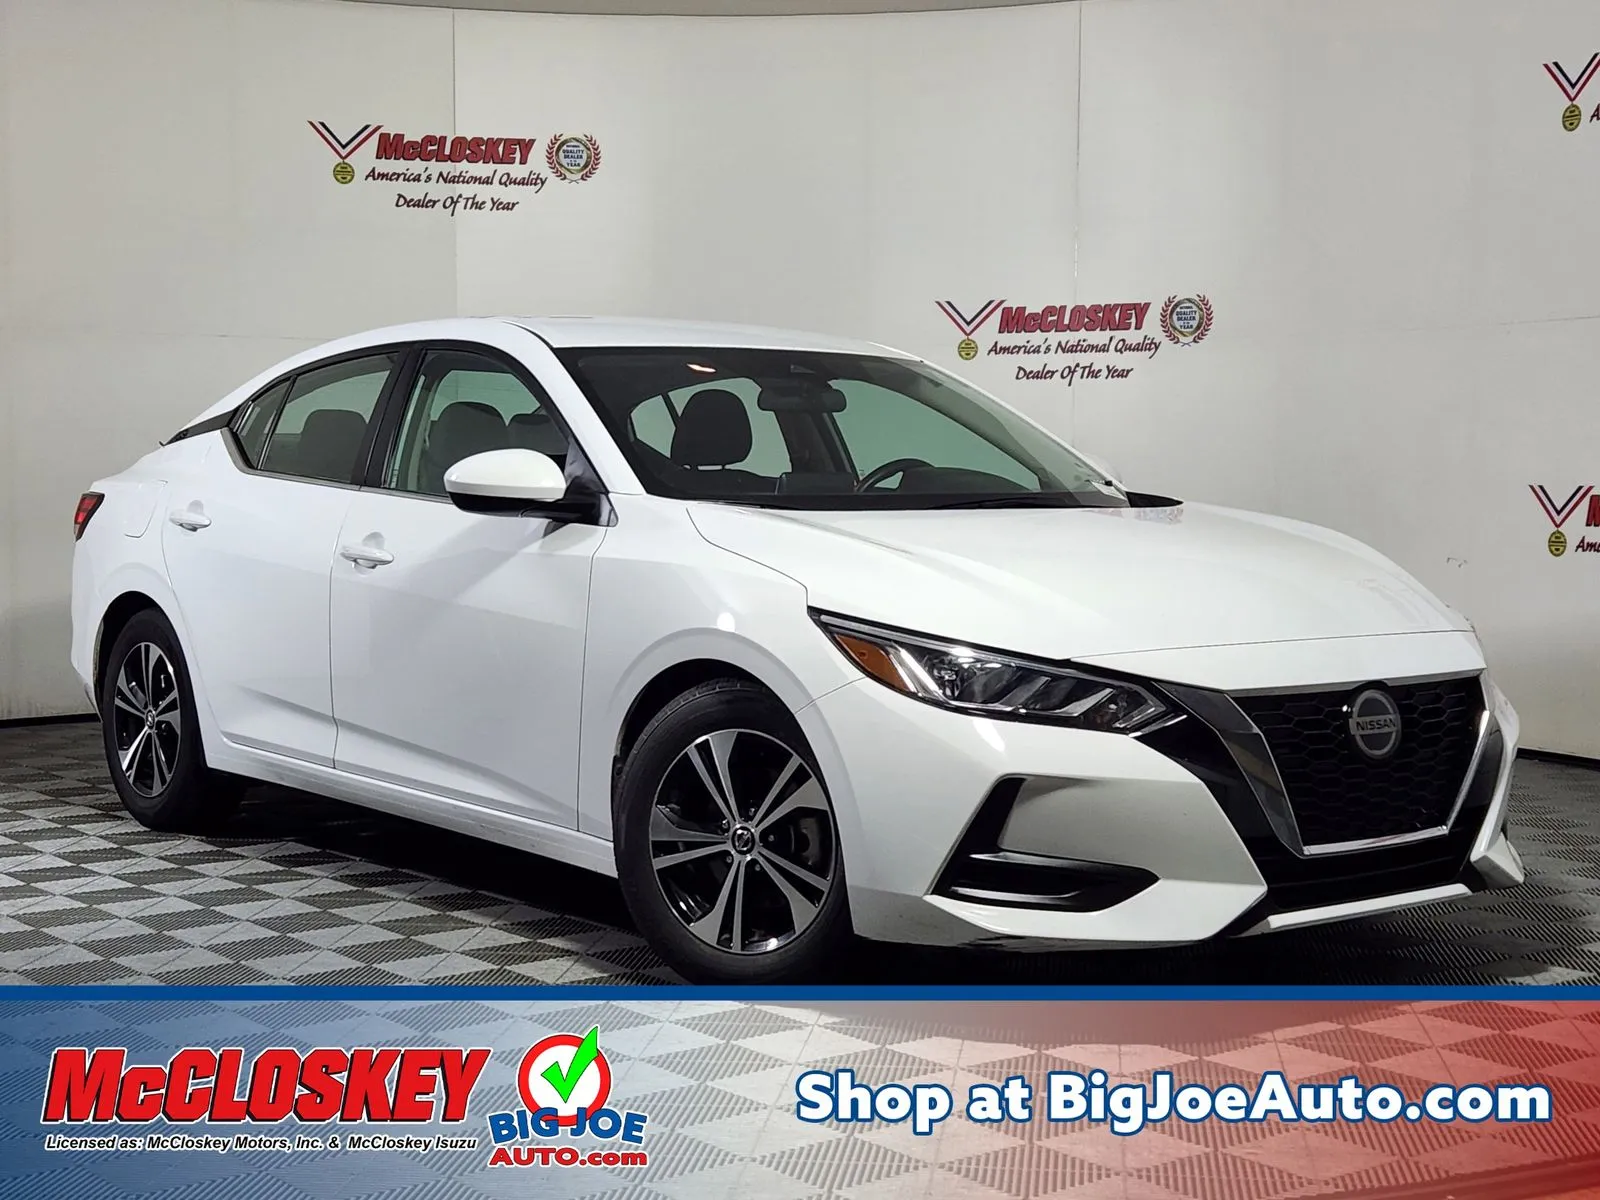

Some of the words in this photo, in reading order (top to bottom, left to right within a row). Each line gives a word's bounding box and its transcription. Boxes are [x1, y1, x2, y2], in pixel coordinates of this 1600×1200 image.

[376, 133, 536, 165] McCLOSKEY
[365, 167, 432, 184] America's
[436, 169, 497, 185] National
[499, 170, 548, 194] Quality
[395, 192, 440, 209] Dealer
[442, 193, 463, 217] Of
[463, 193, 487, 211] The
[490, 197, 520, 212] Year
[998, 302, 1151, 334] McCLOSKEY
[987, 337, 1052, 356] America's
[1054, 335, 1115, 354] National
[1114, 335, 1162, 359] Quality
[1015, 363, 1058, 380] Dealer
[1060, 362, 1080, 387] Of
[1080, 362, 1102, 379] The
[1105, 364, 1134, 380] Year
[1355, 718, 1397, 732] NISSAN
